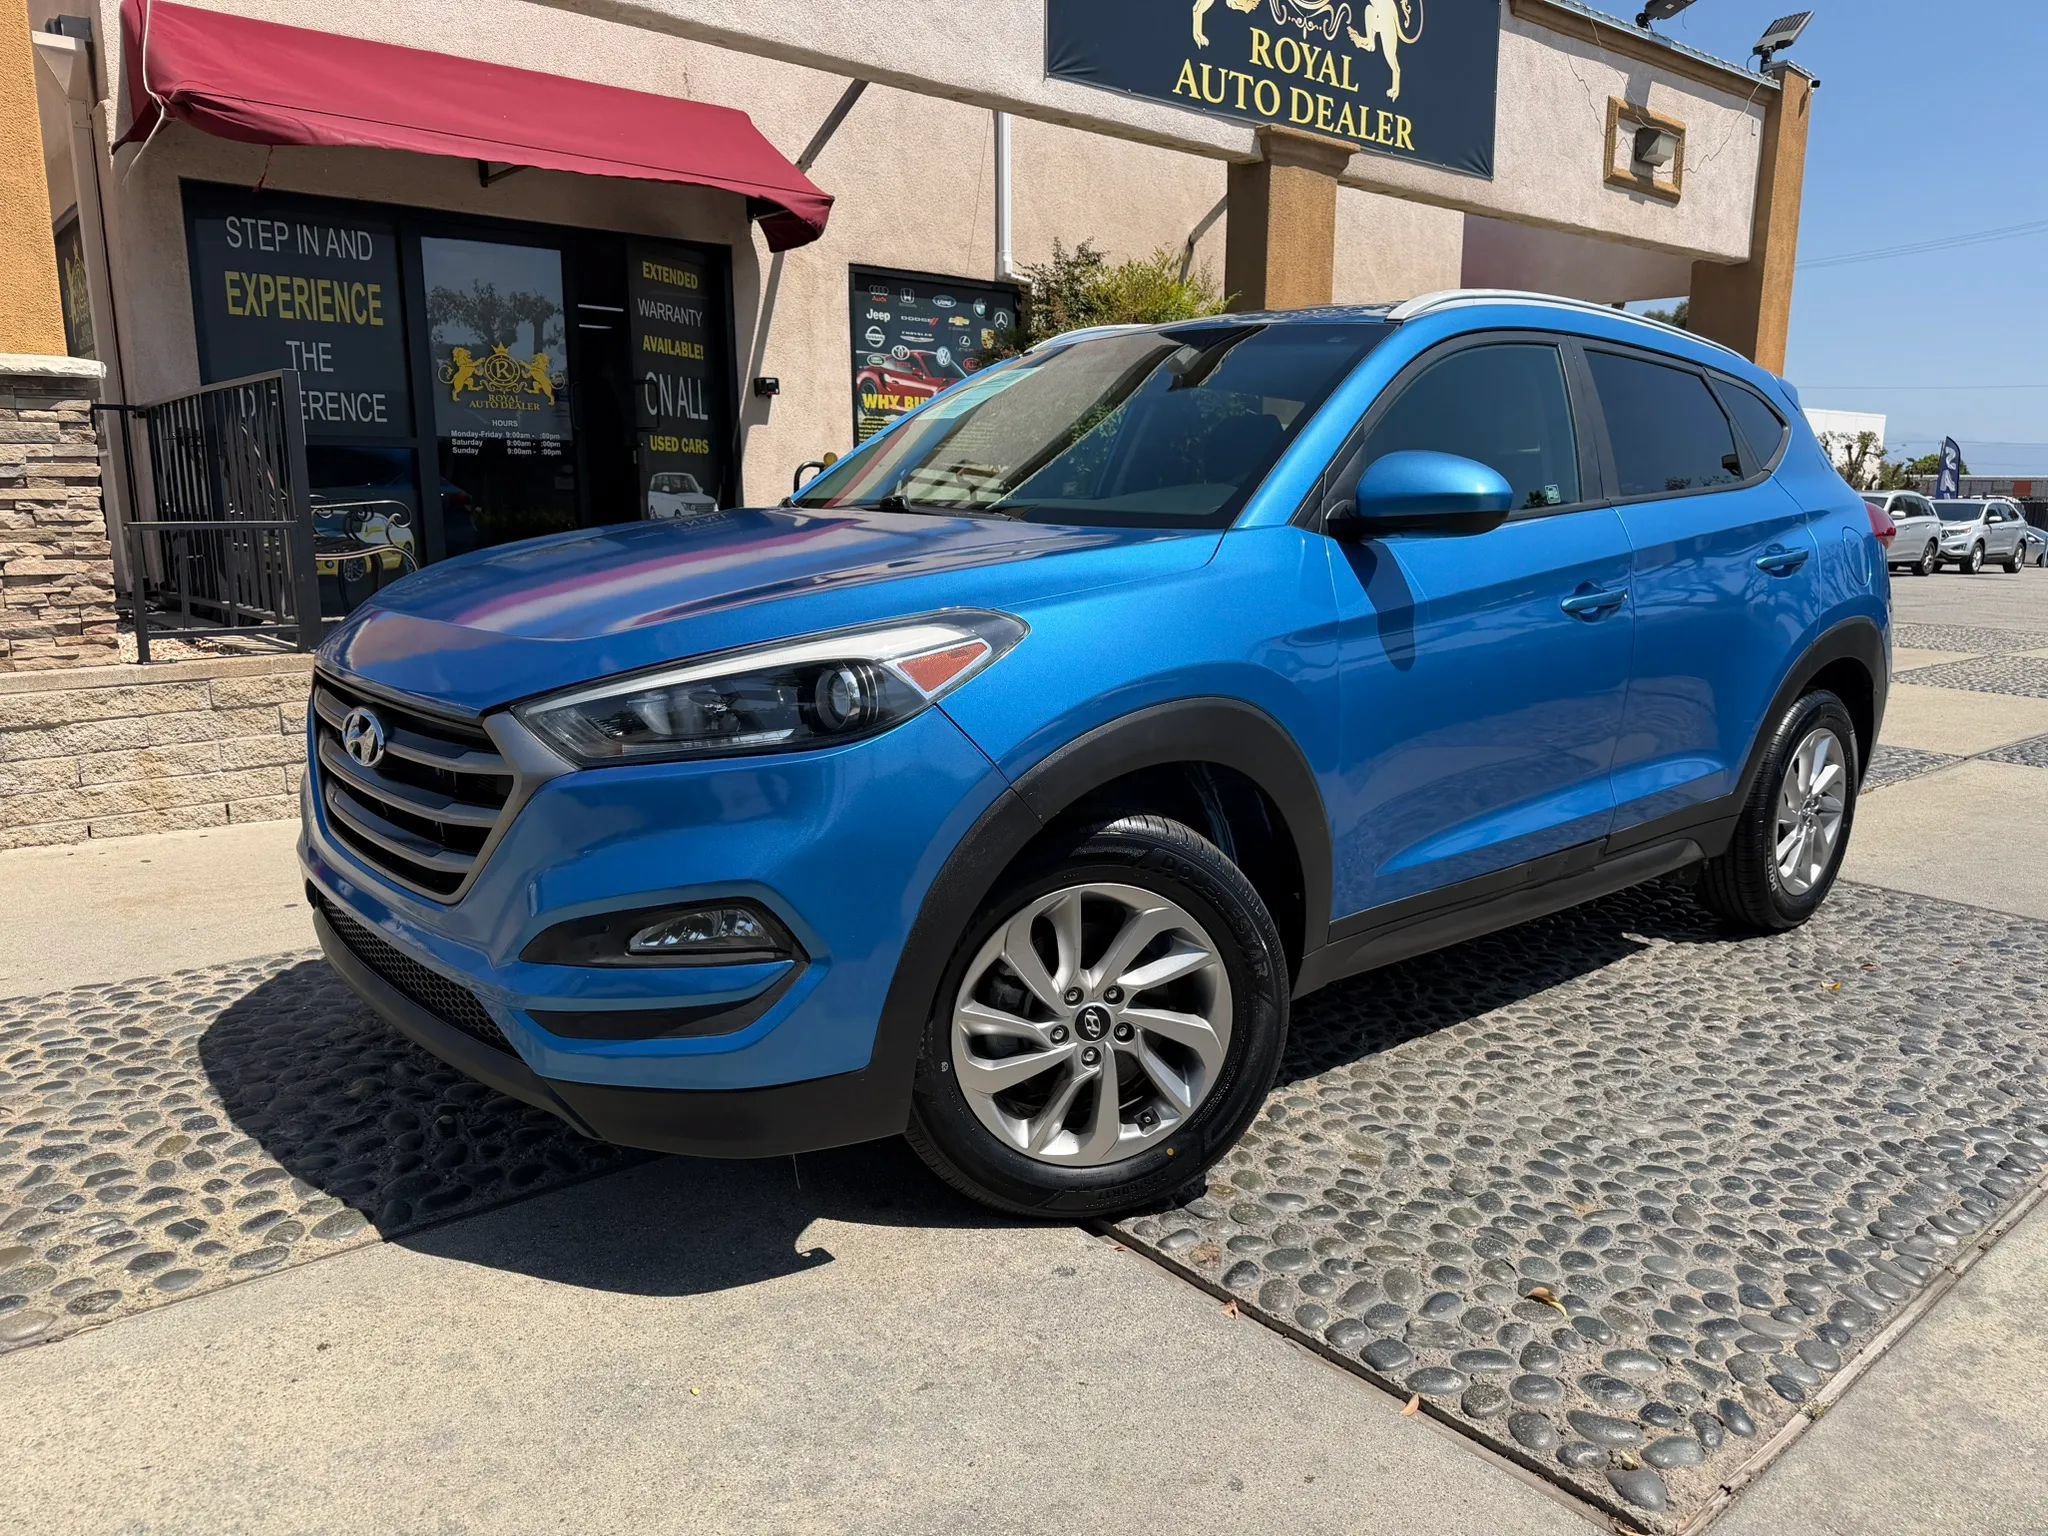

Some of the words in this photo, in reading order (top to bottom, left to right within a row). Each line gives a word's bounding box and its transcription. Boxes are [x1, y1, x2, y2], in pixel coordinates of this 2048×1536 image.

[1250, 27, 1359, 93] ROYAL
[1172, 58, 1280, 116] AUTO
[1289, 87, 1415, 151] DEALER
[226, 216, 289, 252] STEP
[296, 223, 320, 256] IN
[326, 228, 373, 261] AND
[642, 261, 698, 290] EXTENDED
[224, 271, 384, 326] EXPERIENCE
[637, 297, 703, 328] WARRANTY
[866, 308, 891, 323] Jeep
[285, 340, 334, 372] THE
[642, 334, 704, 361] AVAILABLE!
[469, 400, 499, 409] AUTO
[501, 401, 541, 411] DEALER
[488, 394, 521, 403] ROYAL
[645, 371, 673, 417] ON
[676, 376, 709, 421] ALL
[862, 393, 901, 410] WHY
[492, 419, 519, 427] HOURS
[450, 430, 503, 440] Monday-Friday
[451, 438, 483, 447] Saturday
[650, 435, 678, 452] USED
[681, 437, 710, 455] CARS
[452, 447, 479, 456] Sunday
